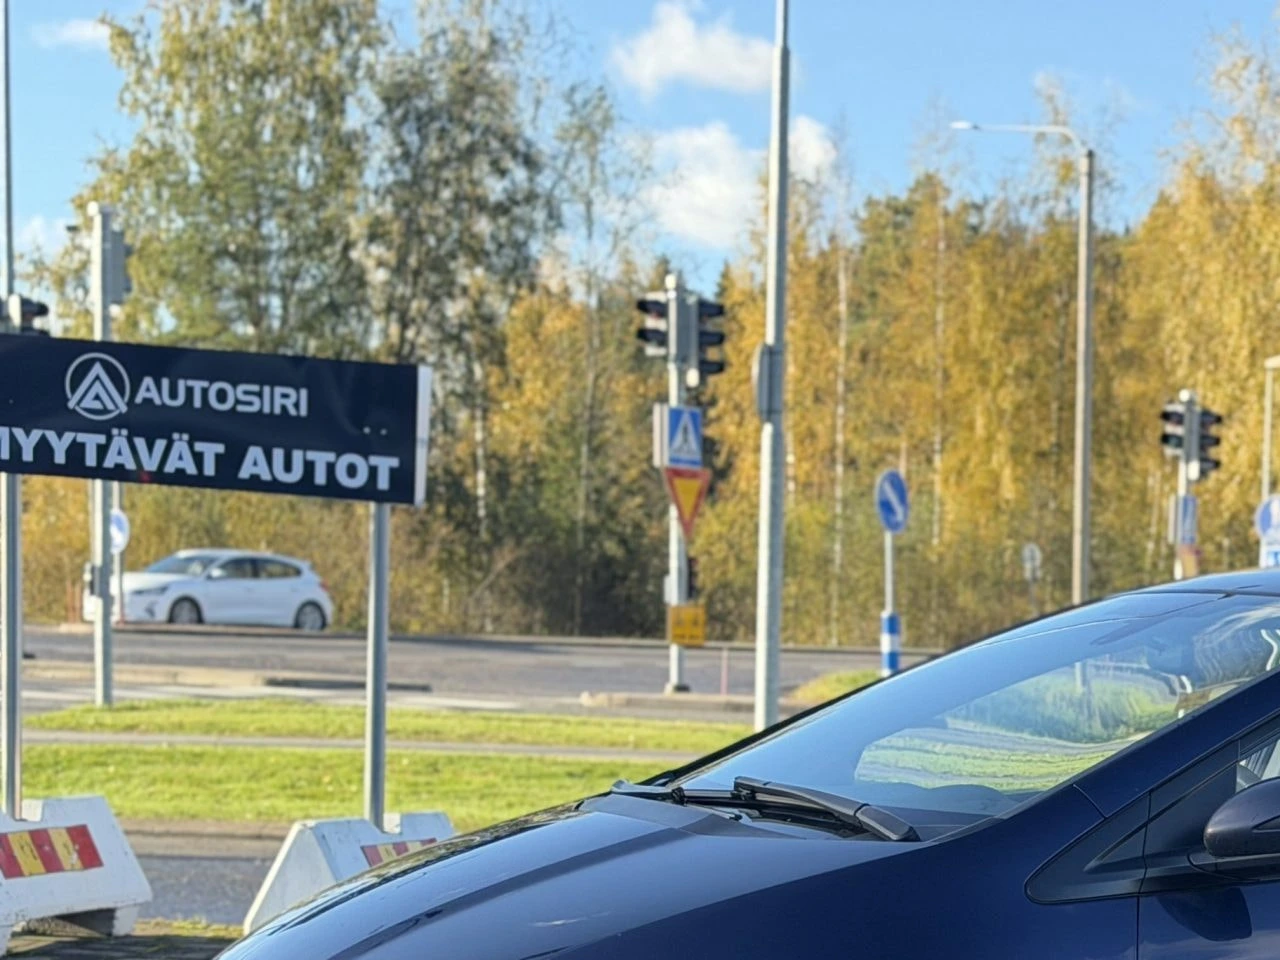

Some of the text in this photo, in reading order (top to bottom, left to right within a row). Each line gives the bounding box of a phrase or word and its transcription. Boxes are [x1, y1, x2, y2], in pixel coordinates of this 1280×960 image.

[135, 376, 307, 417] AUTOSIRI
[0, 426, 399, 491] YYTÄVÄT AUTOT
